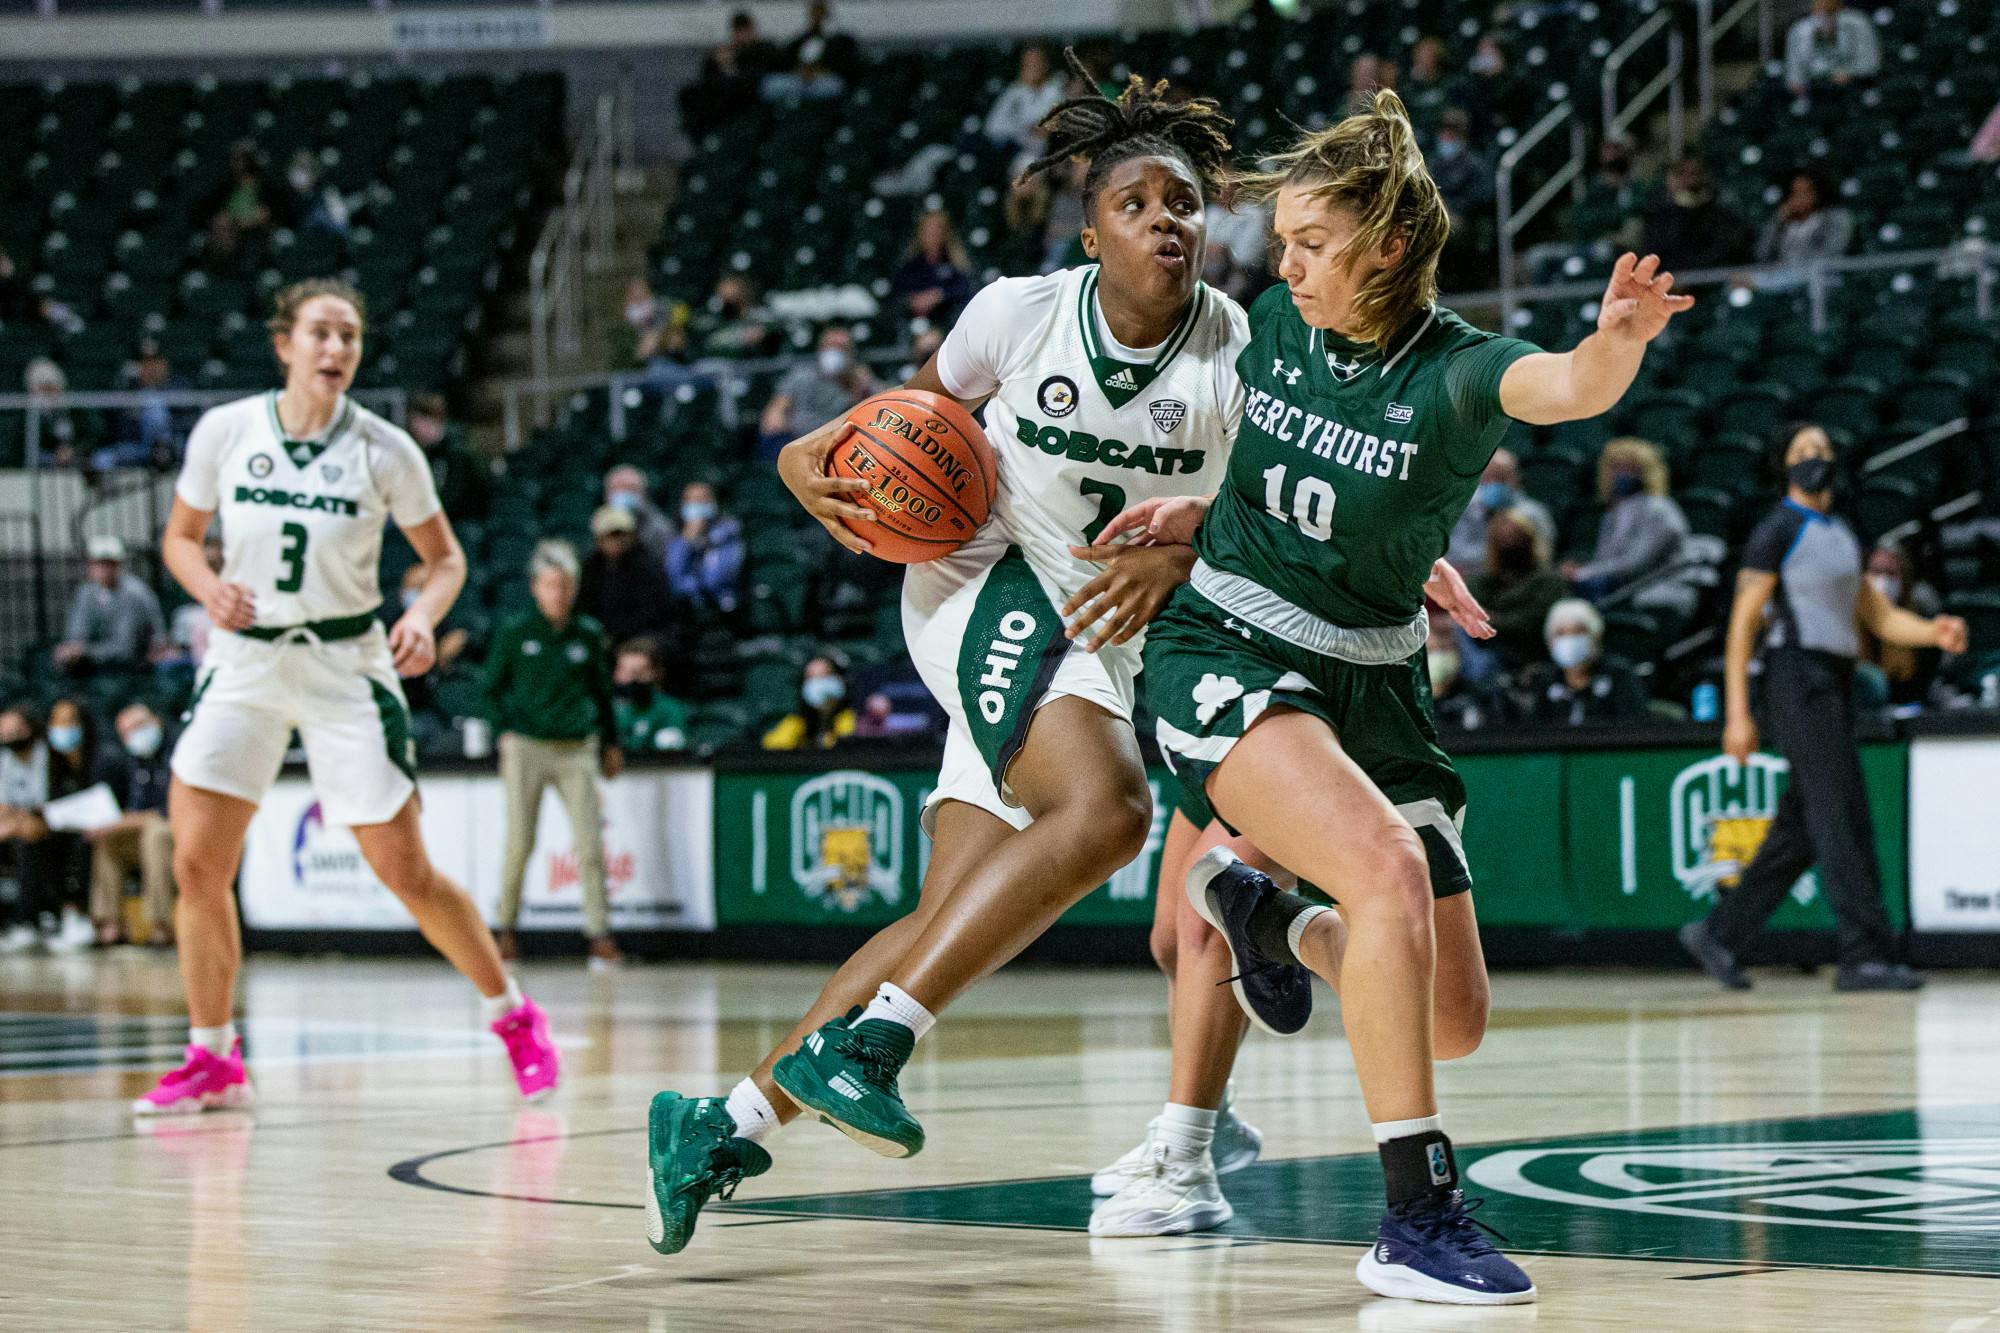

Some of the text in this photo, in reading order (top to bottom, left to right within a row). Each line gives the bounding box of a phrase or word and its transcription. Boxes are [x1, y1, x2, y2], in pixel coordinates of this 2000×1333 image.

[1105, 378, 1138, 391] adidas
[1152, 410, 1185, 419] MAC
[1387, 408, 1411, 419] PSAC
[868, 408, 974, 494] SPALDING
[1016, 415, 1206, 476] BOBCATS
[235, 486, 360, 518] BOBCATS
[848, 446, 942, 524] TF-1000
[866, 487, 902, 513] EGACY
[1262, 463, 1337, 542] 10
[275, 521, 309, 593] 3
[978, 610, 1037, 725] OHIO
